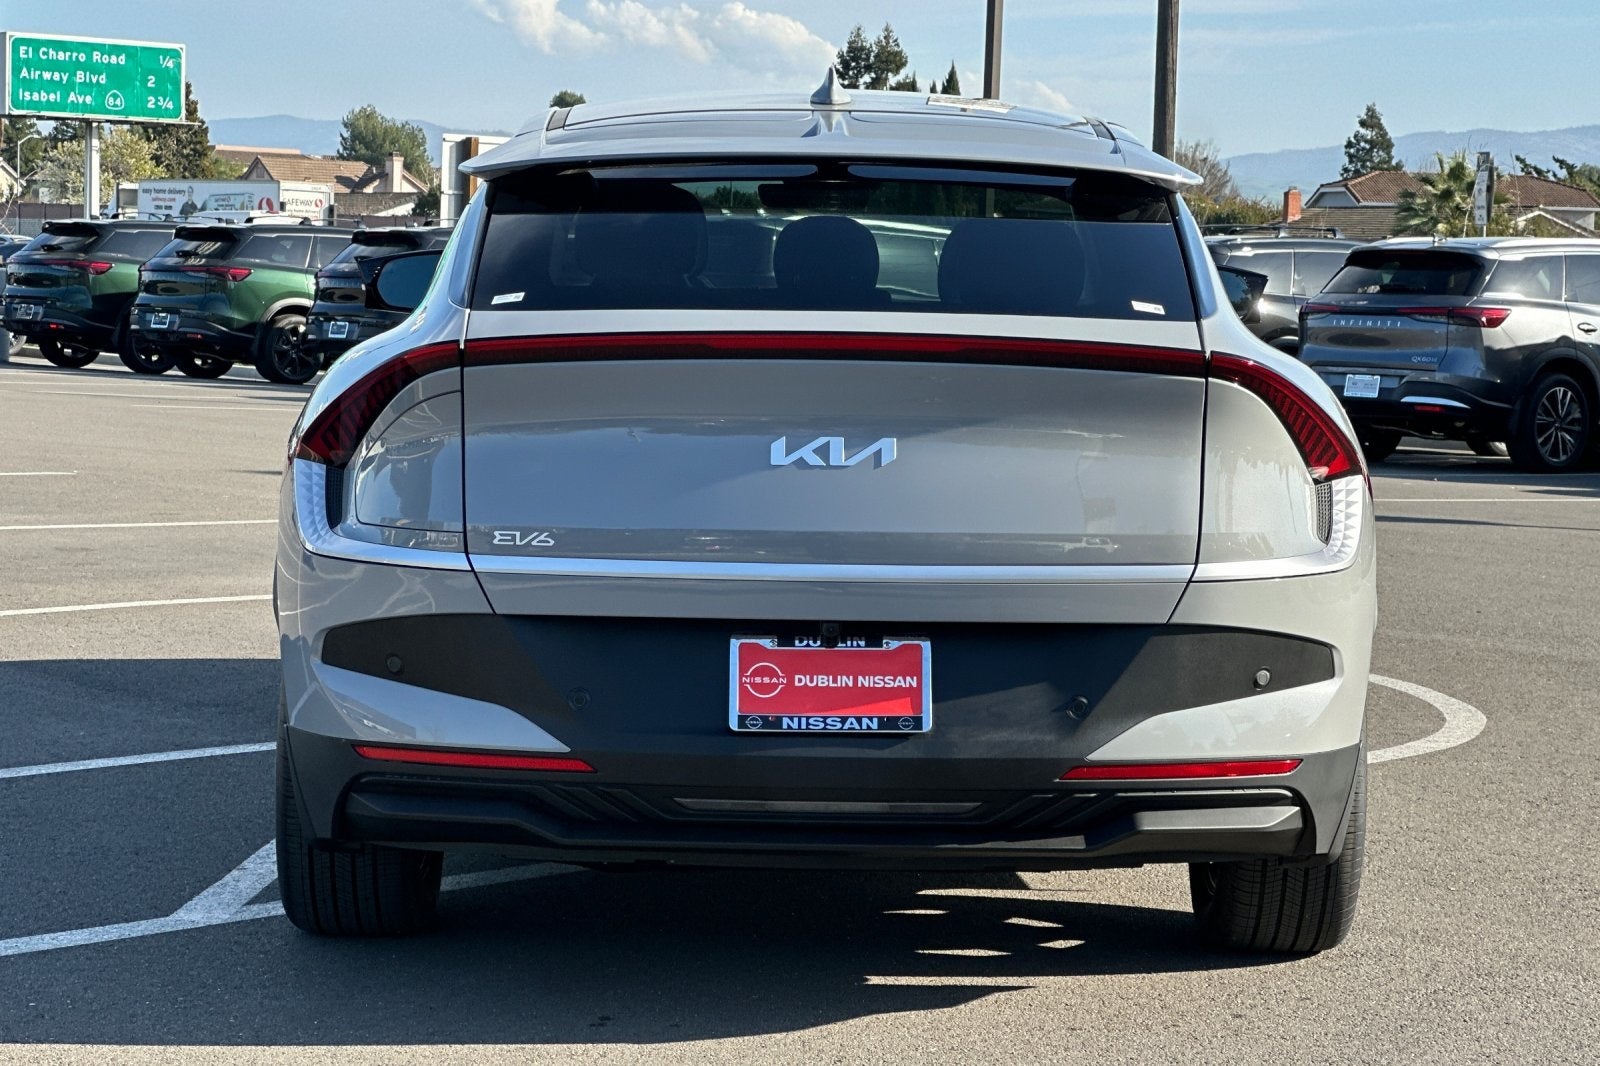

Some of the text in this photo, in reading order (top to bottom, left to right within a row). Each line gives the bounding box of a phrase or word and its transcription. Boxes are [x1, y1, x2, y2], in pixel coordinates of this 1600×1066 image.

[19, 46, 33, 59] El
[39, 47, 86, 62] Charro
[93, 51, 126, 65] Road
[19, 67, 156, 88] Airway Blvd 2
[19, 88, 92, 105] Isabel Ave
[107, 97, 122, 107] 84
[1333, 319, 1401, 327] INFINITI
[770, 436, 897, 466] KIA
[492, 530, 556, 547] EV6
[794, 636, 866, 647] DULIN
[742, 676, 787, 684] NISSAN
[794, 674, 917, 688] DUBLIN NISSAN
[782, 716, 878, 730] NISSAN
